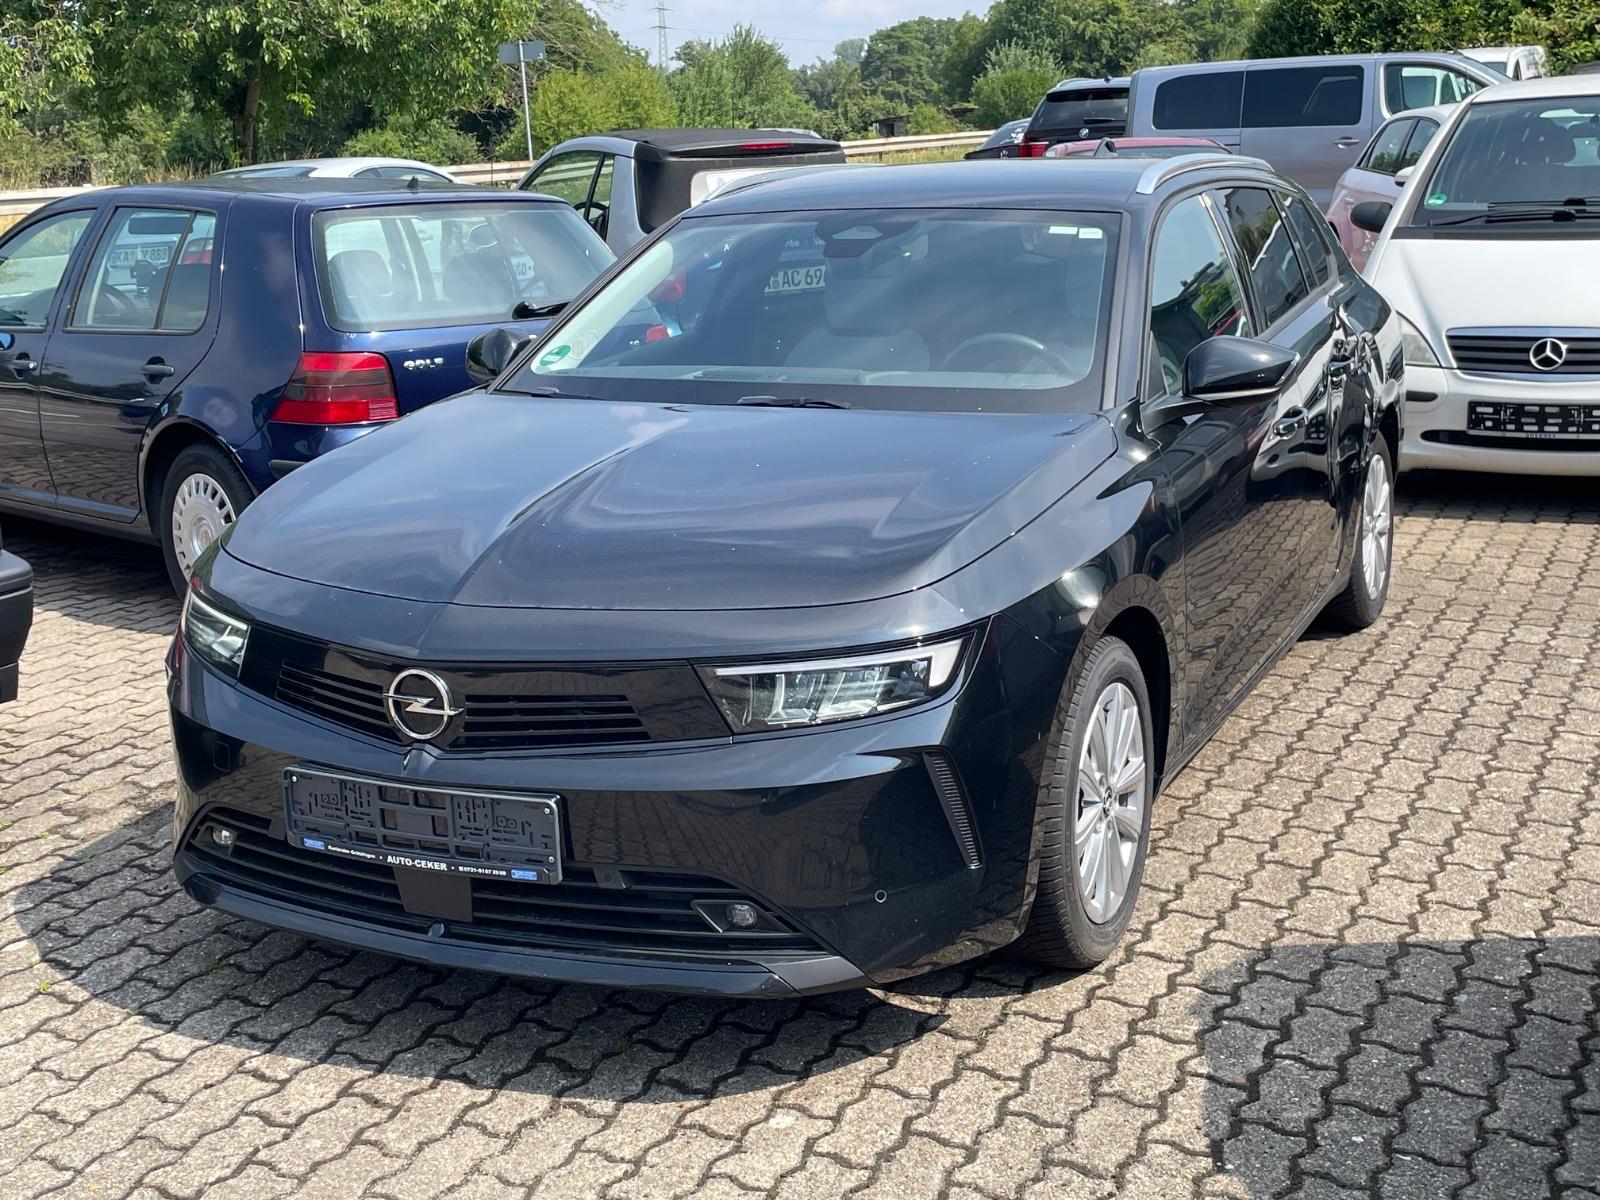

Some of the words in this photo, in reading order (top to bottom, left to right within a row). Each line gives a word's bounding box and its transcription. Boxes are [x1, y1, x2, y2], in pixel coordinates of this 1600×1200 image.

[782, 270, 801, 288] AC
[804, 267, 826, 286] 69
[403, 357, 444, 370] GOLF
[387, 855, 448, 870] AUTO-CEKER
